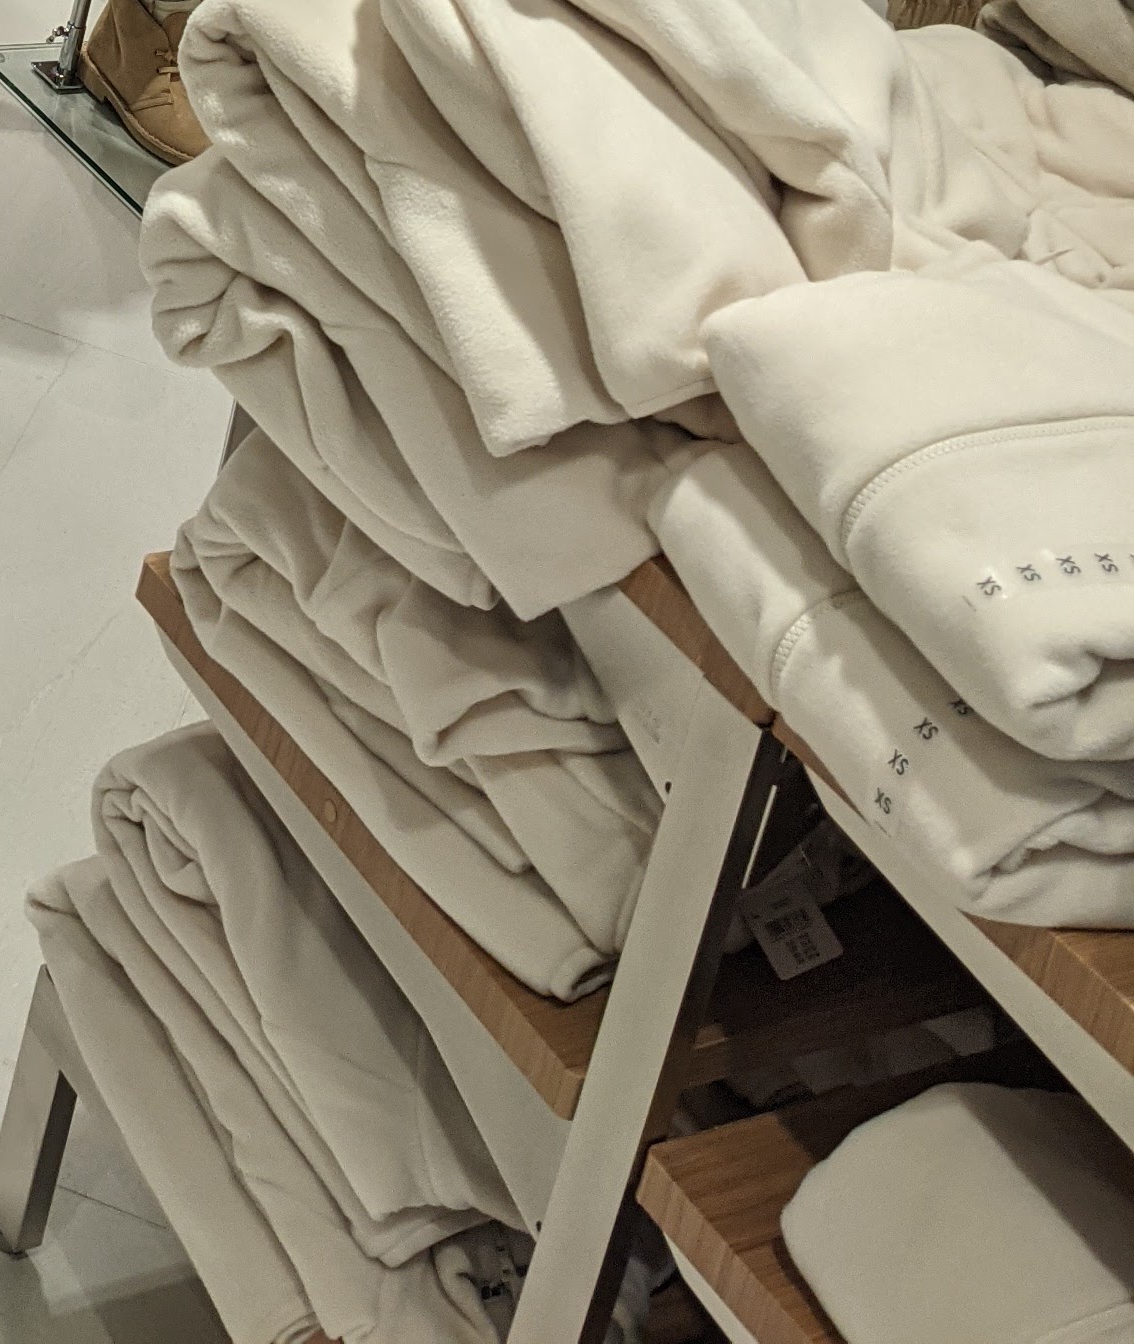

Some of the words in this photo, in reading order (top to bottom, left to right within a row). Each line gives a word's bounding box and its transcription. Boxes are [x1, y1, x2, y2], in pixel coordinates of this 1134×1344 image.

[1016, 563, 1042, 582] XS
[1055, 555, 1082, 575] XS
[1093, 552, 1119, 573] XS
[976, 575, 1002, 596] XS
[913, 717, 939, 740] XS
[888, 749, 909, 776] XS
[874, 787, 892, 814] XS
